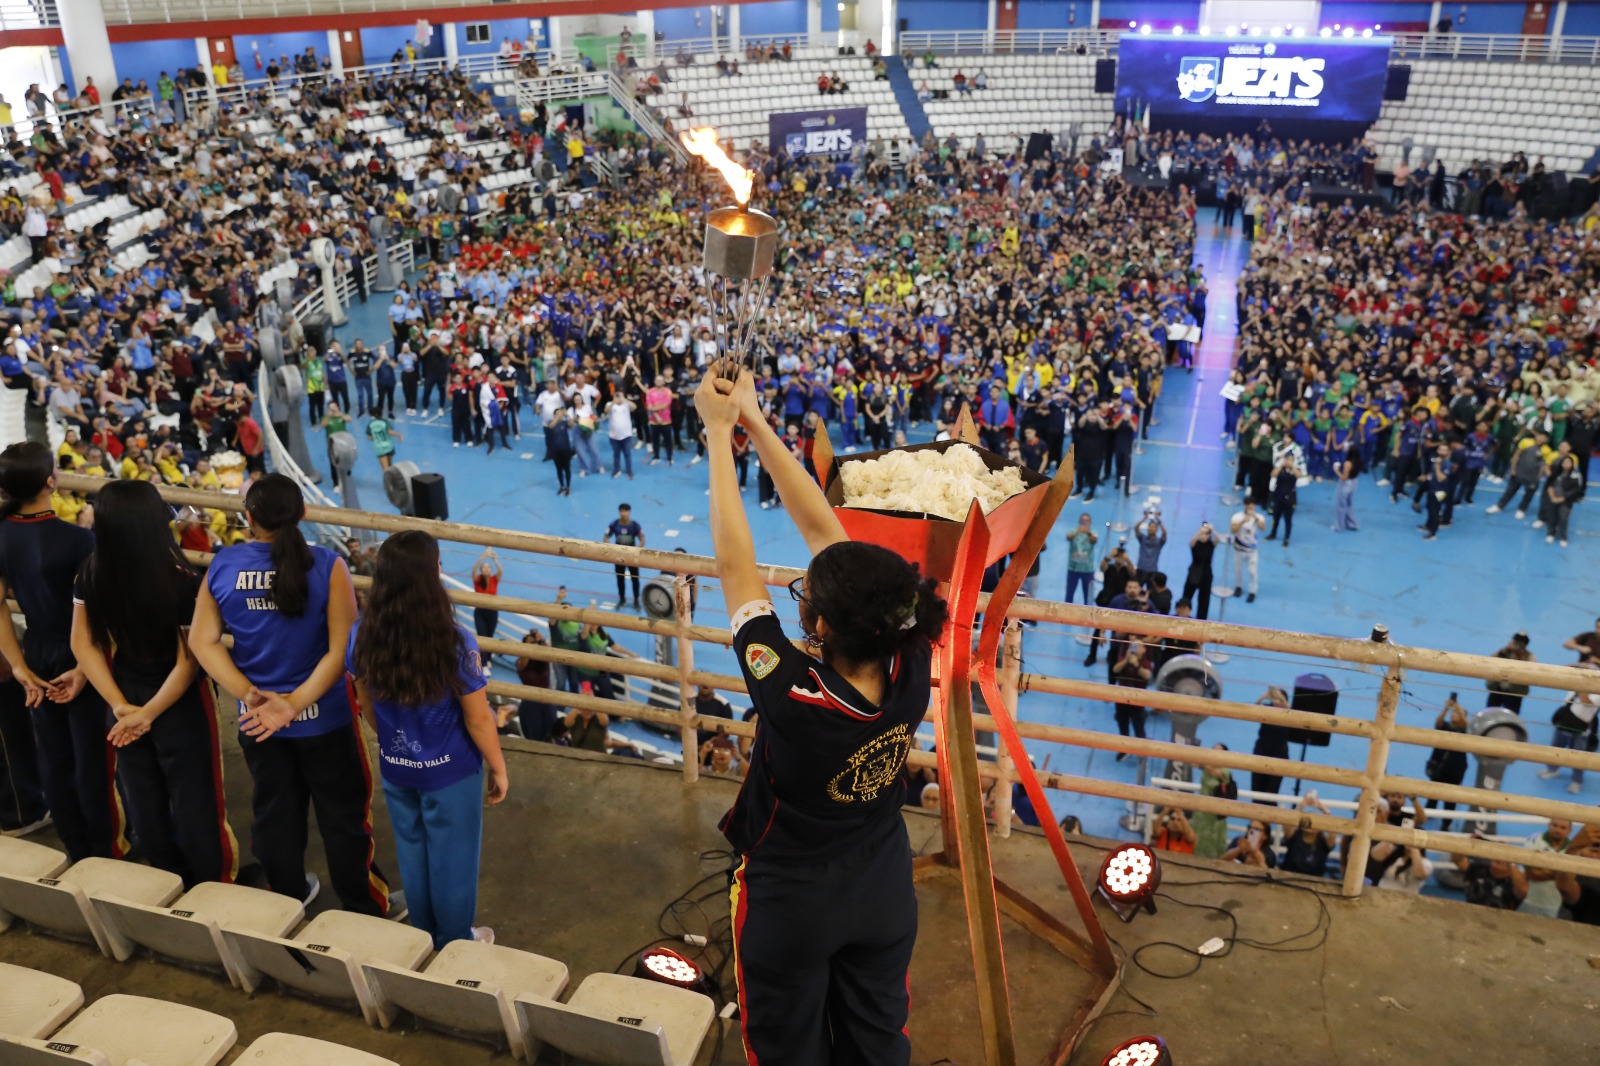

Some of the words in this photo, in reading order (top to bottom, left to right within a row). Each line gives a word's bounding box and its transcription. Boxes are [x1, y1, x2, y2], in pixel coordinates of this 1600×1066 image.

[235, 570, 277, 590] ATLE
[425, 754, 451, 768] VALLE
[861, 790, 878, 802] XIX
